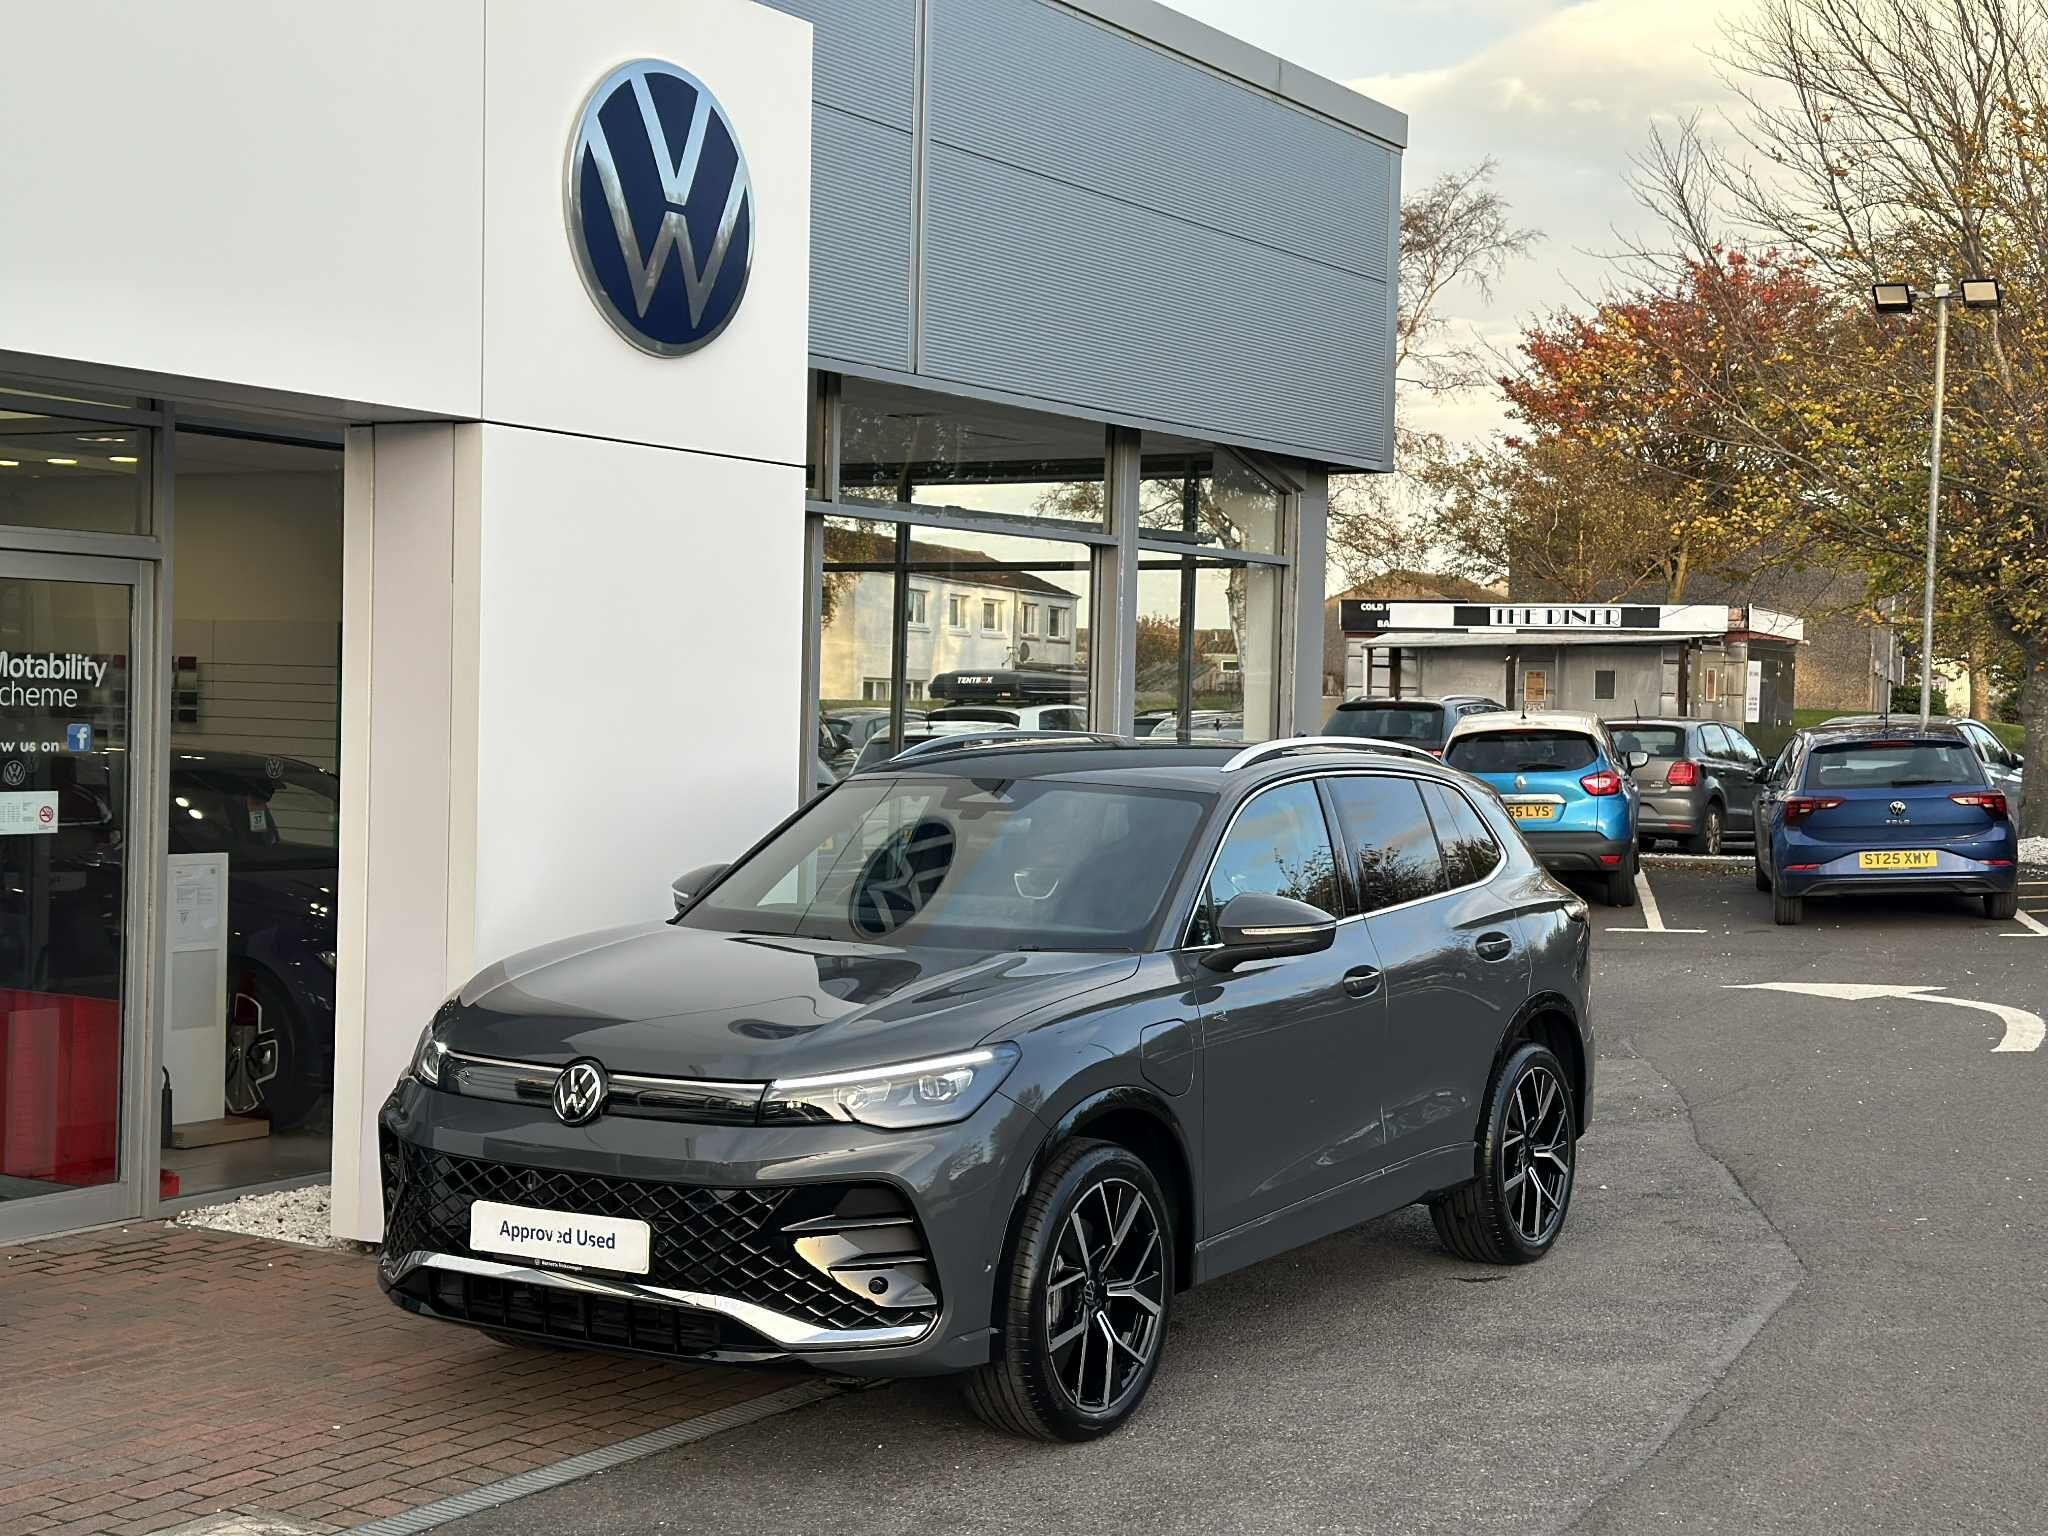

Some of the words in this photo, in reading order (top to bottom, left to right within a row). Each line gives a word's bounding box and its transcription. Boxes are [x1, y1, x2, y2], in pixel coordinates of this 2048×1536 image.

[1360, 603, 1384, 611] COLD
[1491, 608, 1537, 625] THE
[1546, 608, 1620, 625] DINER
[20, 742, 37, 752] us
[41, 742, 60, 752] on
[1526, 806, 1550, 817] LYS
[1864, 853, 1901, 865] ST25
[499, 1219, 572, 1245] Approved
[576, 1228, 616, 1250] Used
